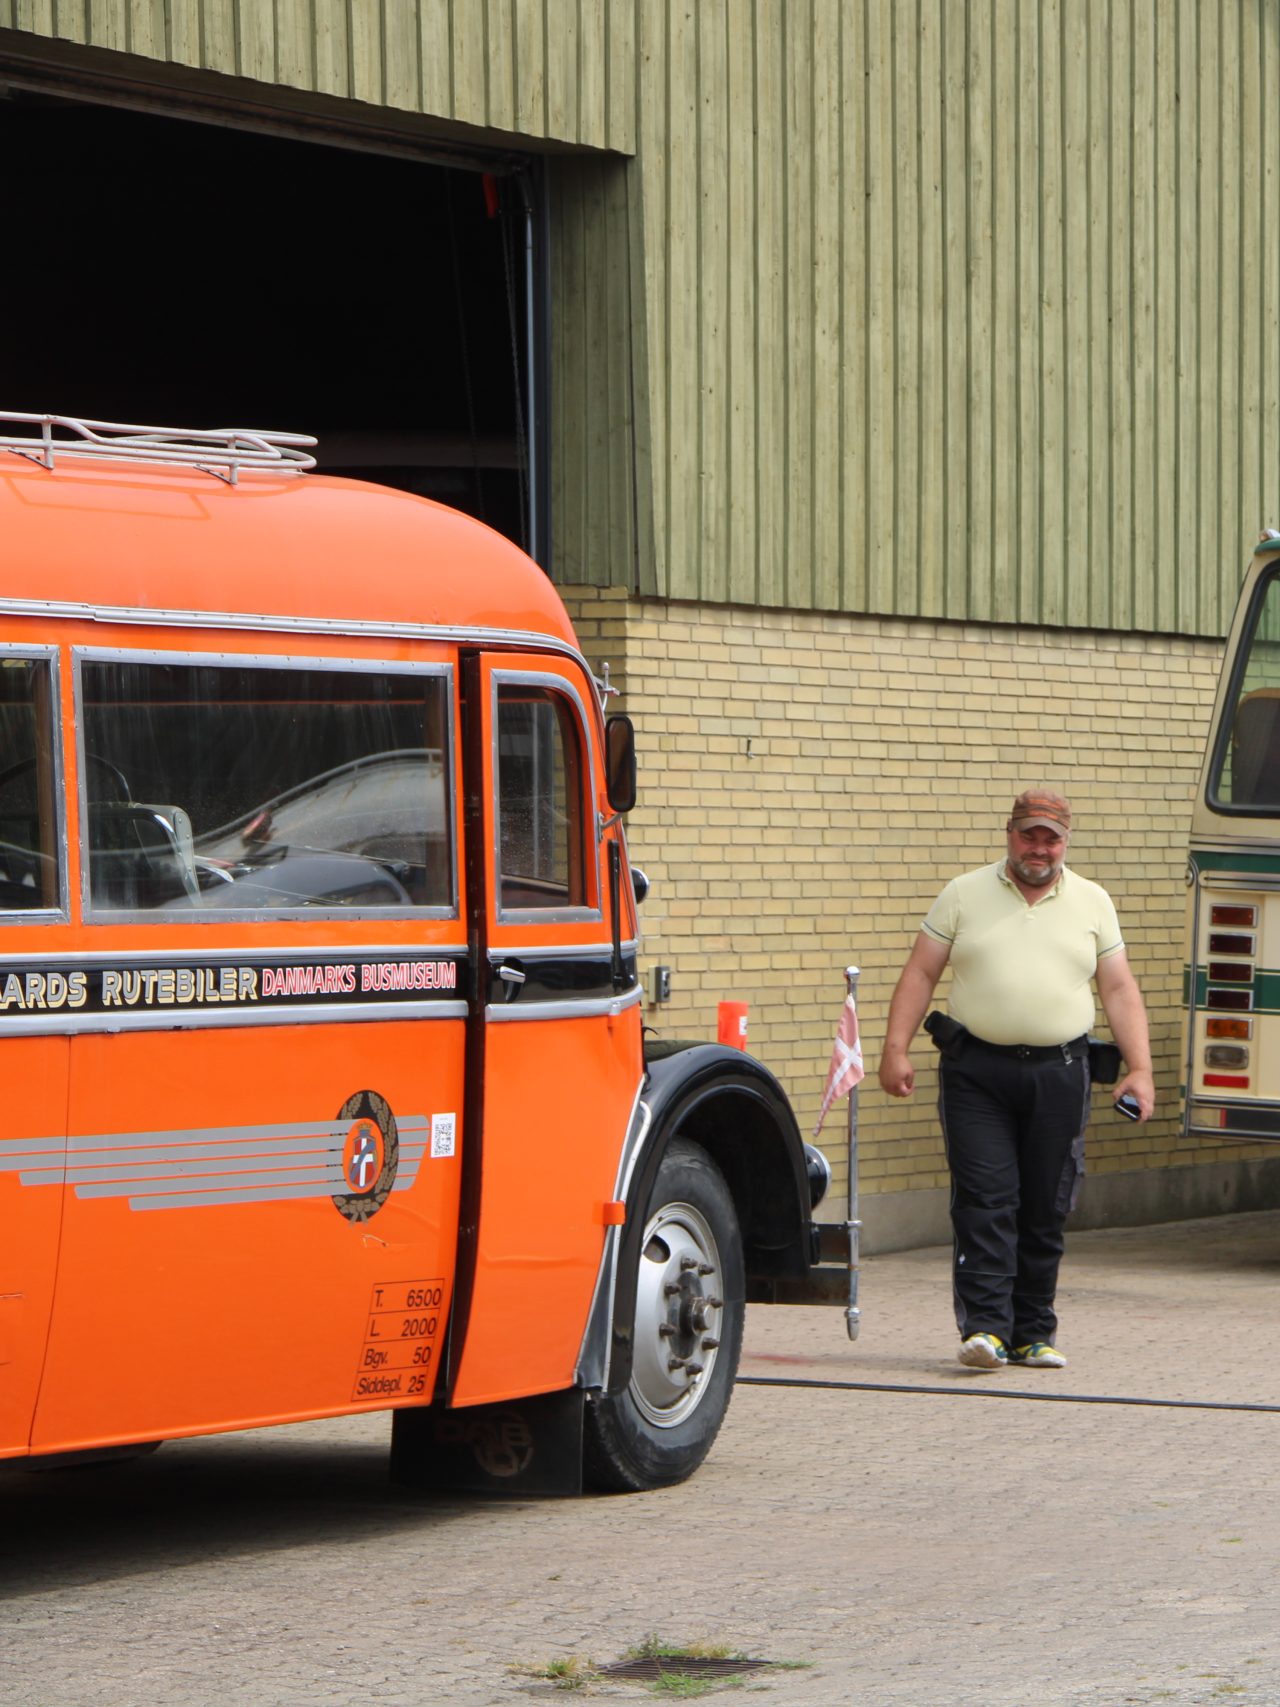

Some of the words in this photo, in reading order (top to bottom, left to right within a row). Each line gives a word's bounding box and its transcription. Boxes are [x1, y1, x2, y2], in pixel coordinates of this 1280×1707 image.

[0, 972, 87, 1009] ARDS
[102, 966, 258, 1006] RUTEBILER
[262, 965, 355, 996] DANMARKS
[361, 962, 456, 991] BUSMUSEUM
[406, 1288, 441, 1308] 6500
[401, 1317, 437, 1337] 2000
[364, 1348, 388, 1369] Bgv.
[412, 1346, 431, 1364] 50
[407, 1374, 425, 1393] 25
